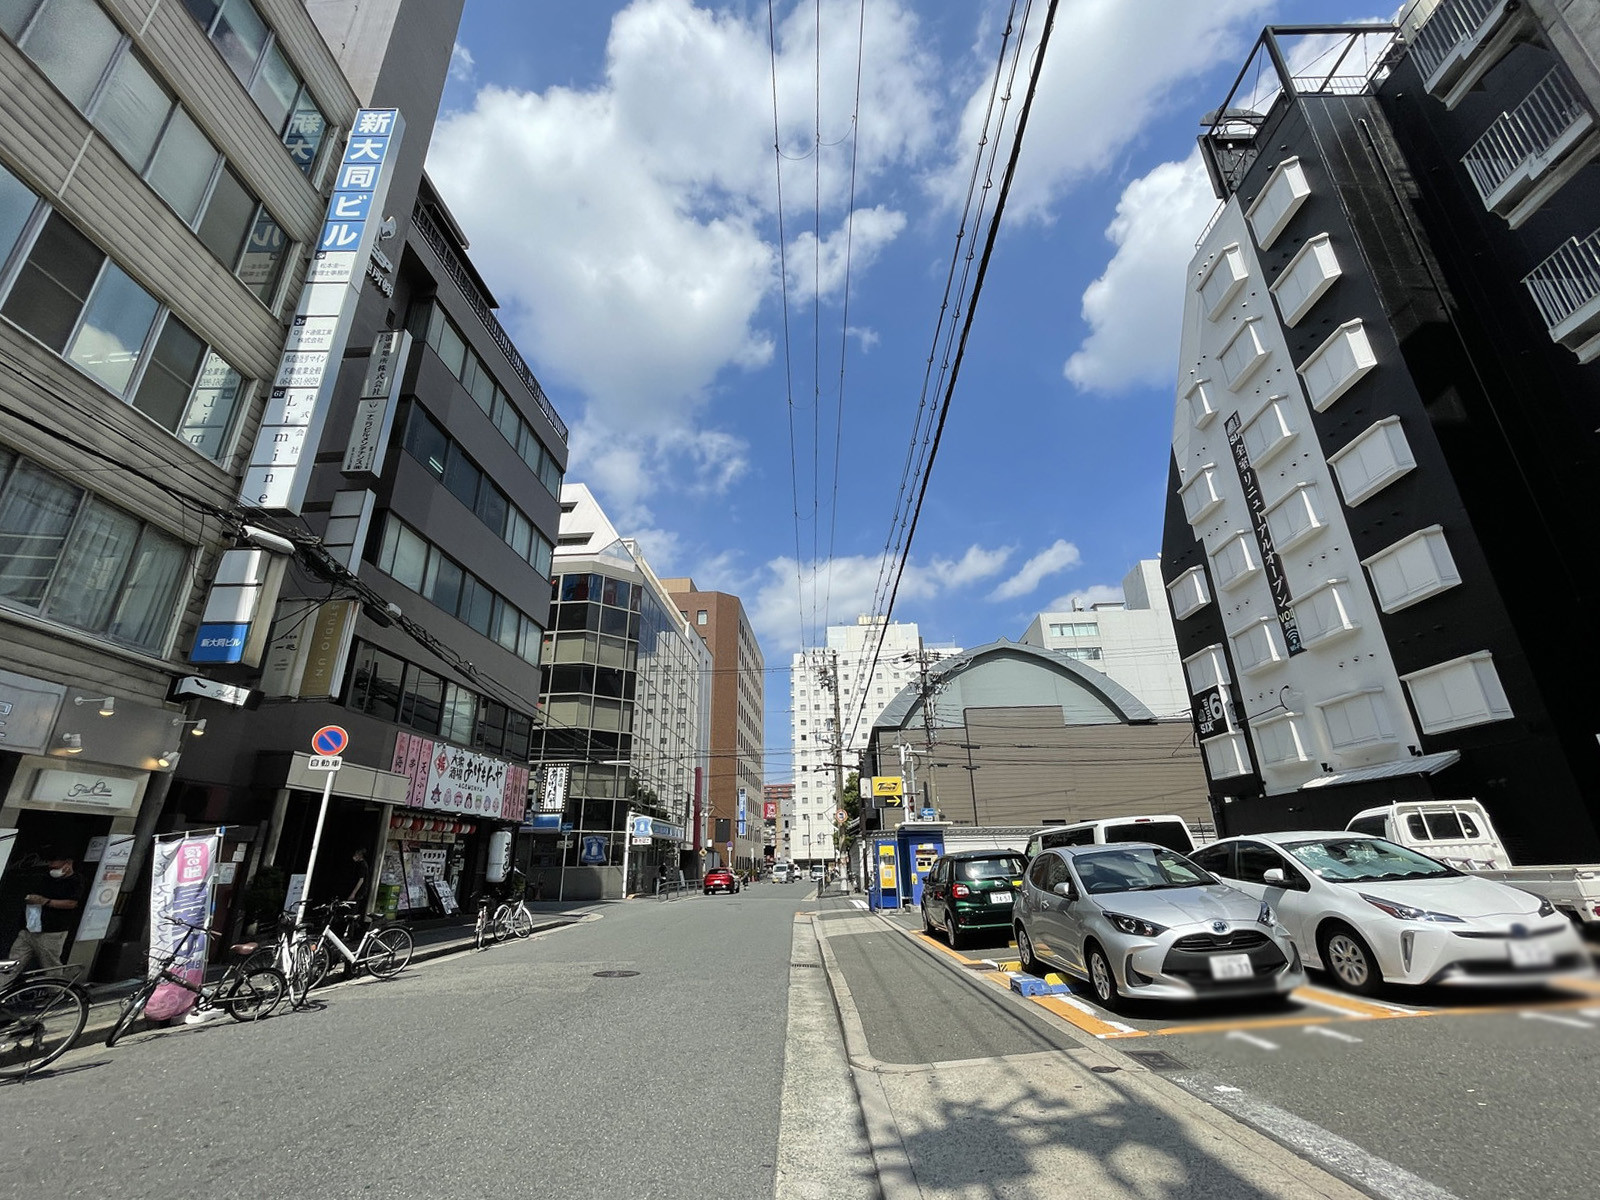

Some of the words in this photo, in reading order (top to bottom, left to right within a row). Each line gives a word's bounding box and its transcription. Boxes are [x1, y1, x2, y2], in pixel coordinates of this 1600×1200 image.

[323, 112, 391, 247] 新大同ビル
[258, 395, 297, 504] Limine
[321, 604, 340, 651] STUDIO
[200, 637, 241, 648] 新大同ビル
[1208, 692, 1224, 719] 6
[1200, 721, 1214, 734] SIX
[310, 759, 340, 767] 自動車
